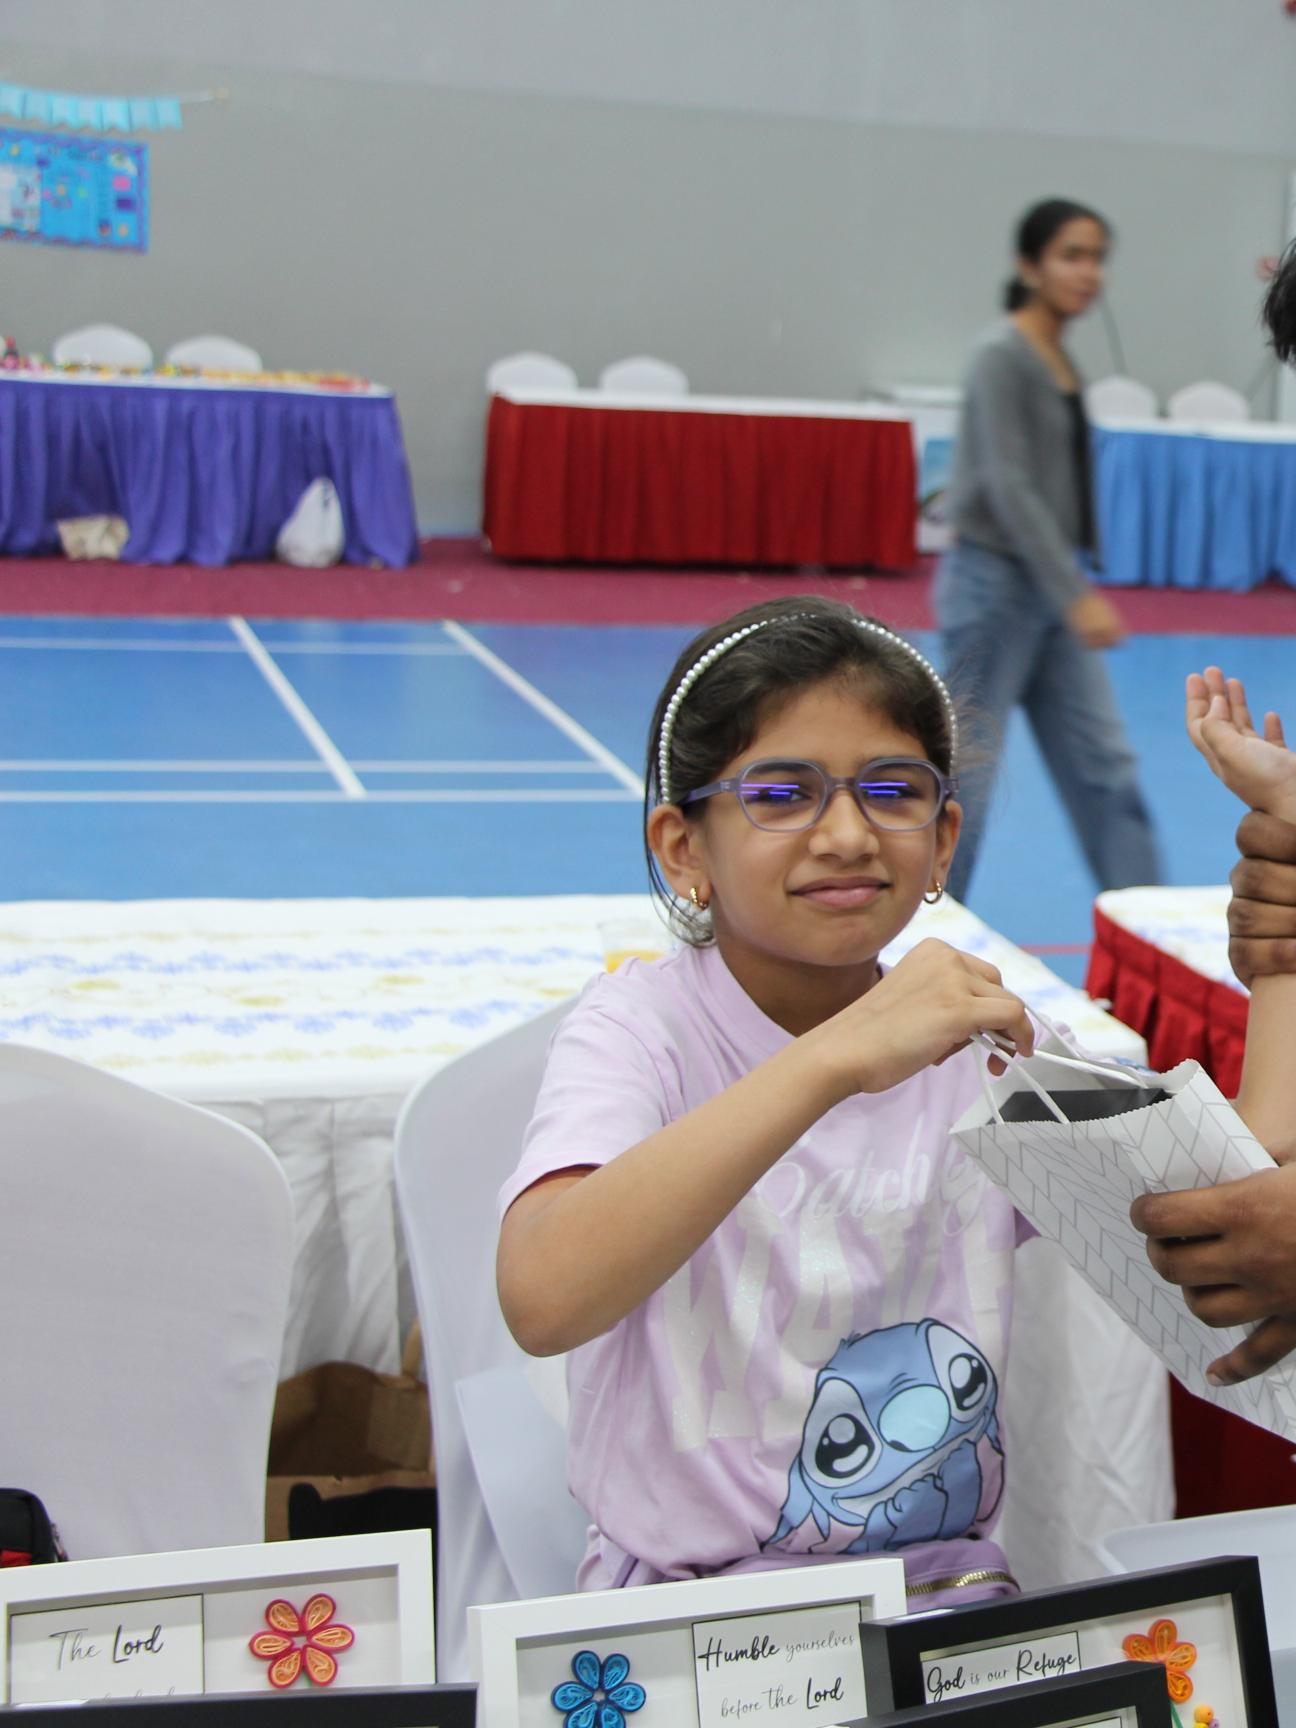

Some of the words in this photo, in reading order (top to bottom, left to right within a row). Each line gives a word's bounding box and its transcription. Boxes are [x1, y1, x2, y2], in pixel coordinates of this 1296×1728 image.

[48, 1627, 102, 1671] The
[112, 1623, 164, 1664] Lord
[697, 1634, 780, 1672] Humble
[783, 1630, 855, 1663] yourselves
[720, 1694, 763, 1720] before
[761, 1683, 799, 1710] the
[805, 1676, 845, 1710] Lord
[926, 1665, 967, 1703] God
[970, 1672, 981, 1686] is
[986, 1668, 1010, 1683] our
[1015, 1648, 1077, 1682] Refuge
